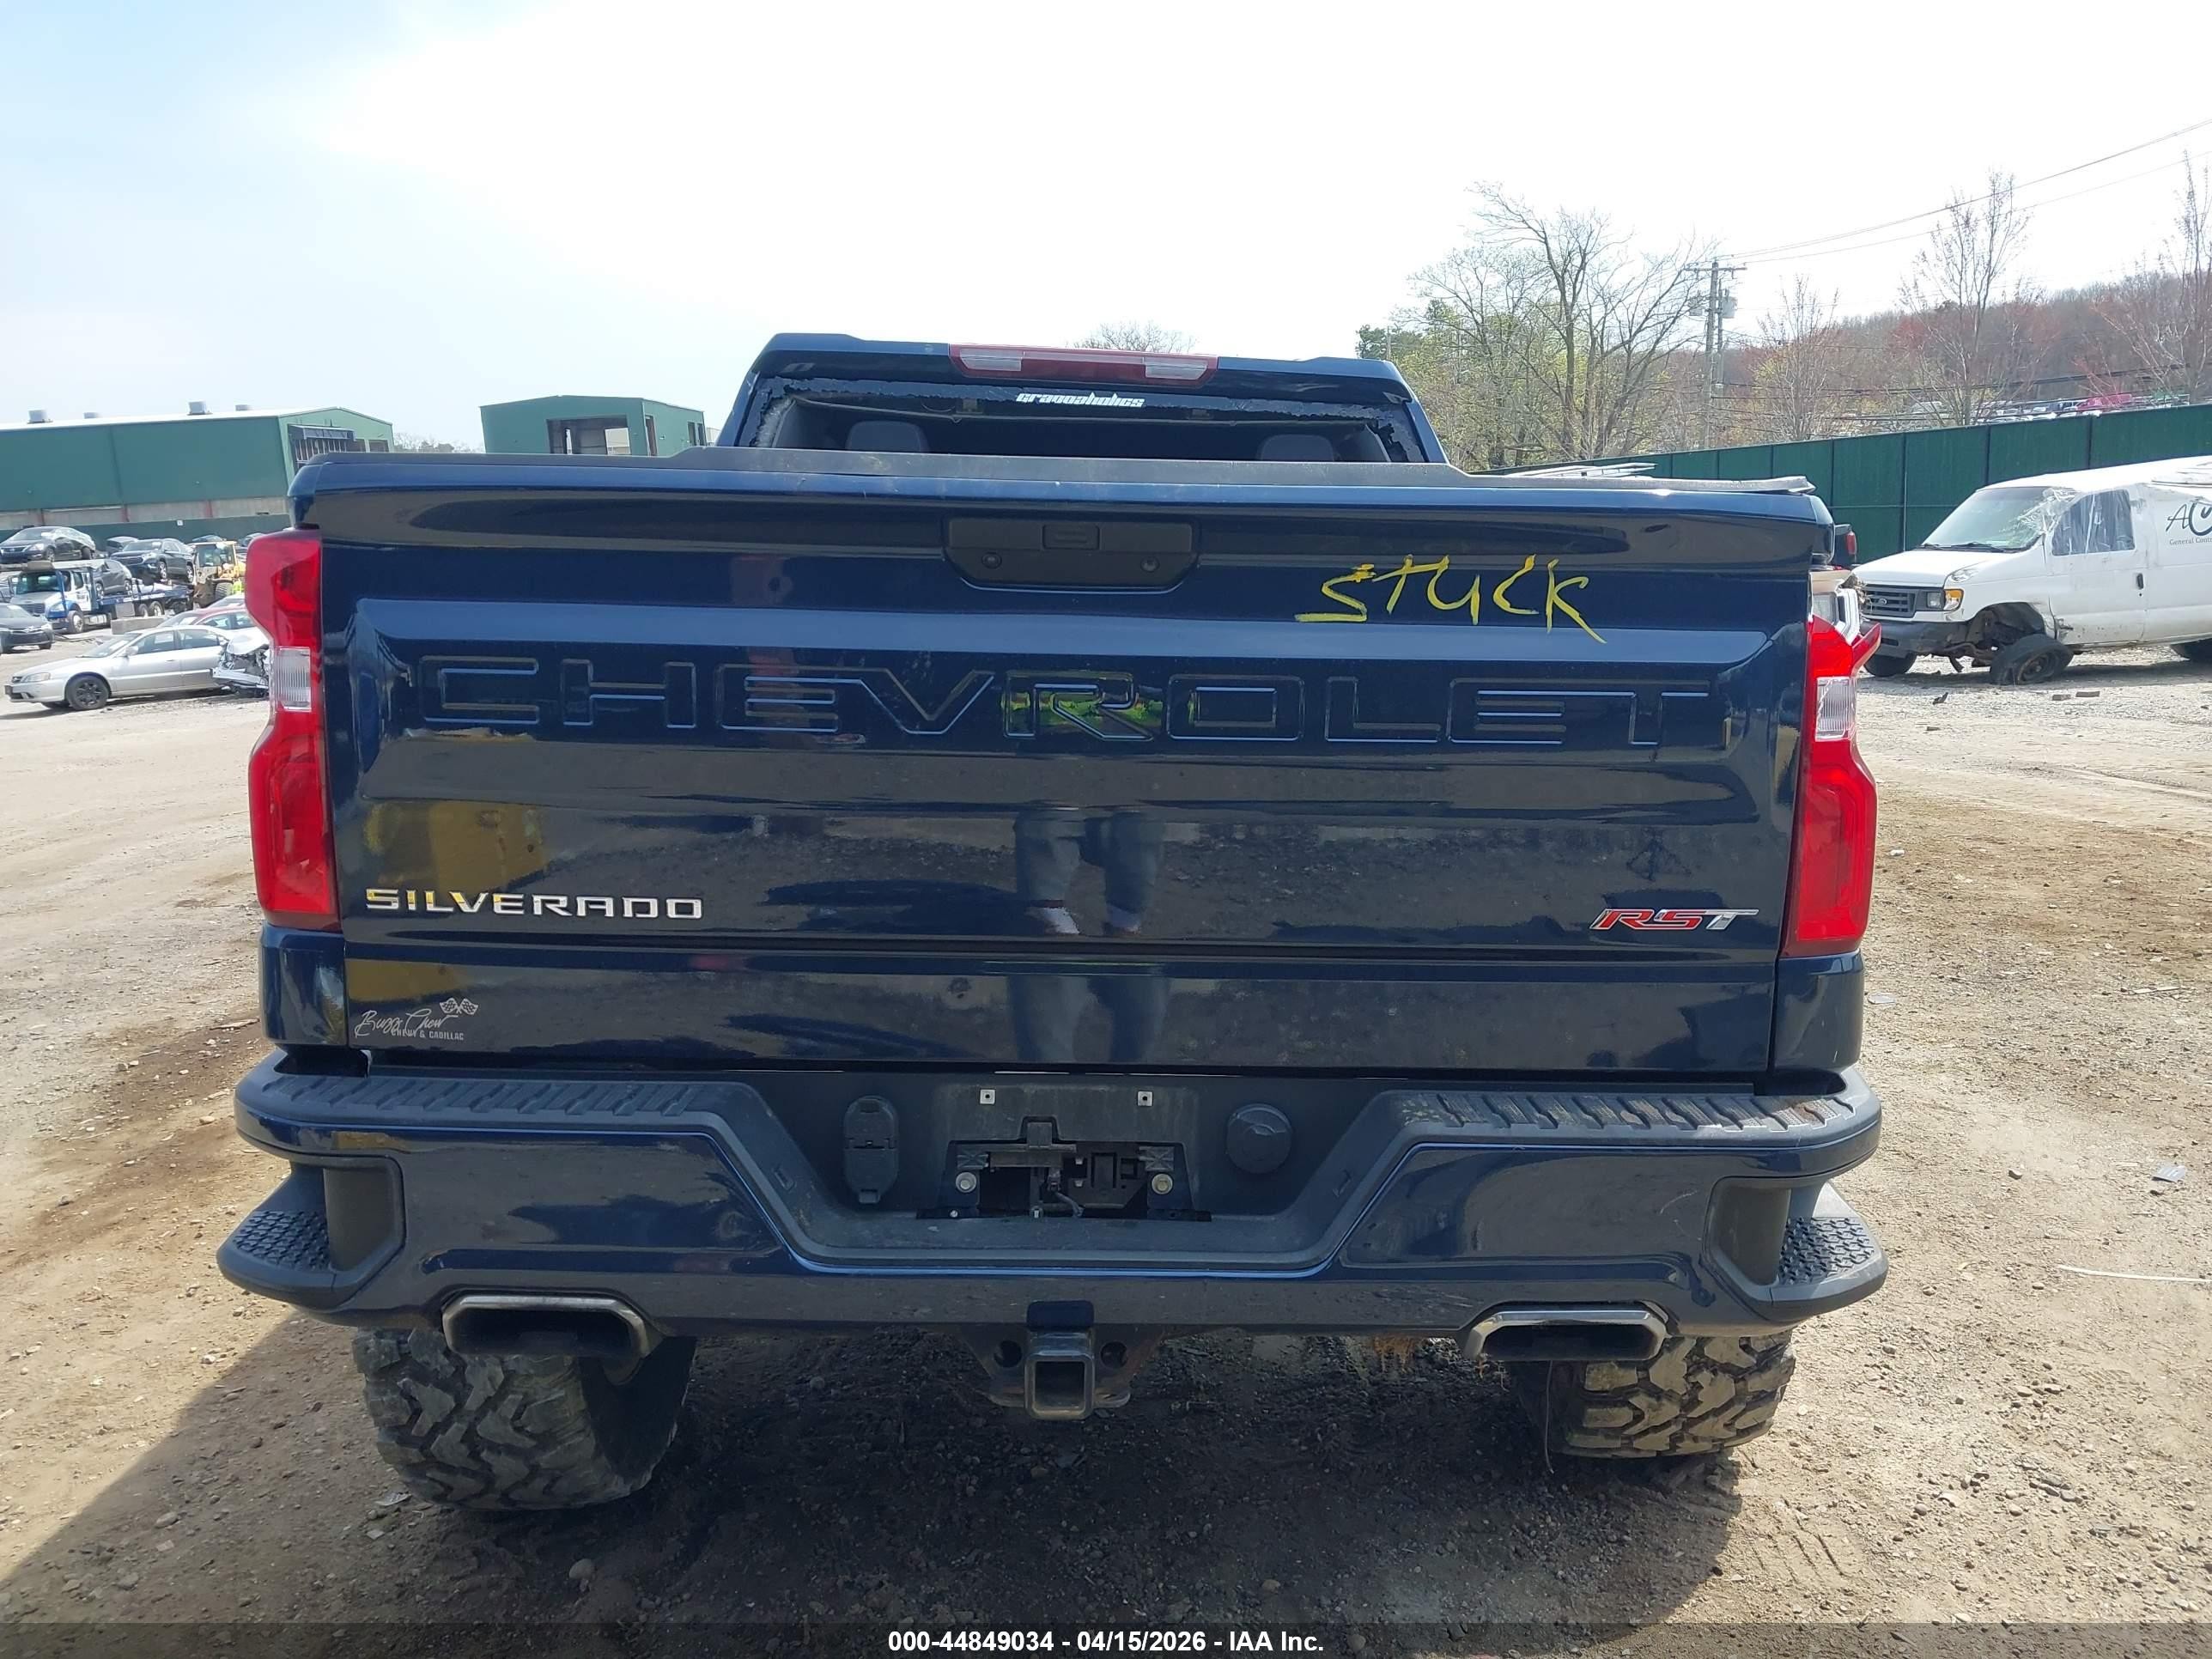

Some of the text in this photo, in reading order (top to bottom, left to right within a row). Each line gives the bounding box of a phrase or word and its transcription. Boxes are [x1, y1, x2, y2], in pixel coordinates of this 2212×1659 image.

[1294, 554, 1607, 644] STUCK
[420, 655, 1711, 745] CHEVROLET
[366, 888, 704, 920] SILVERADO
[1589, 908, 1759, 931] RST
[428, 1031, 465, 1041] CADILLAC
